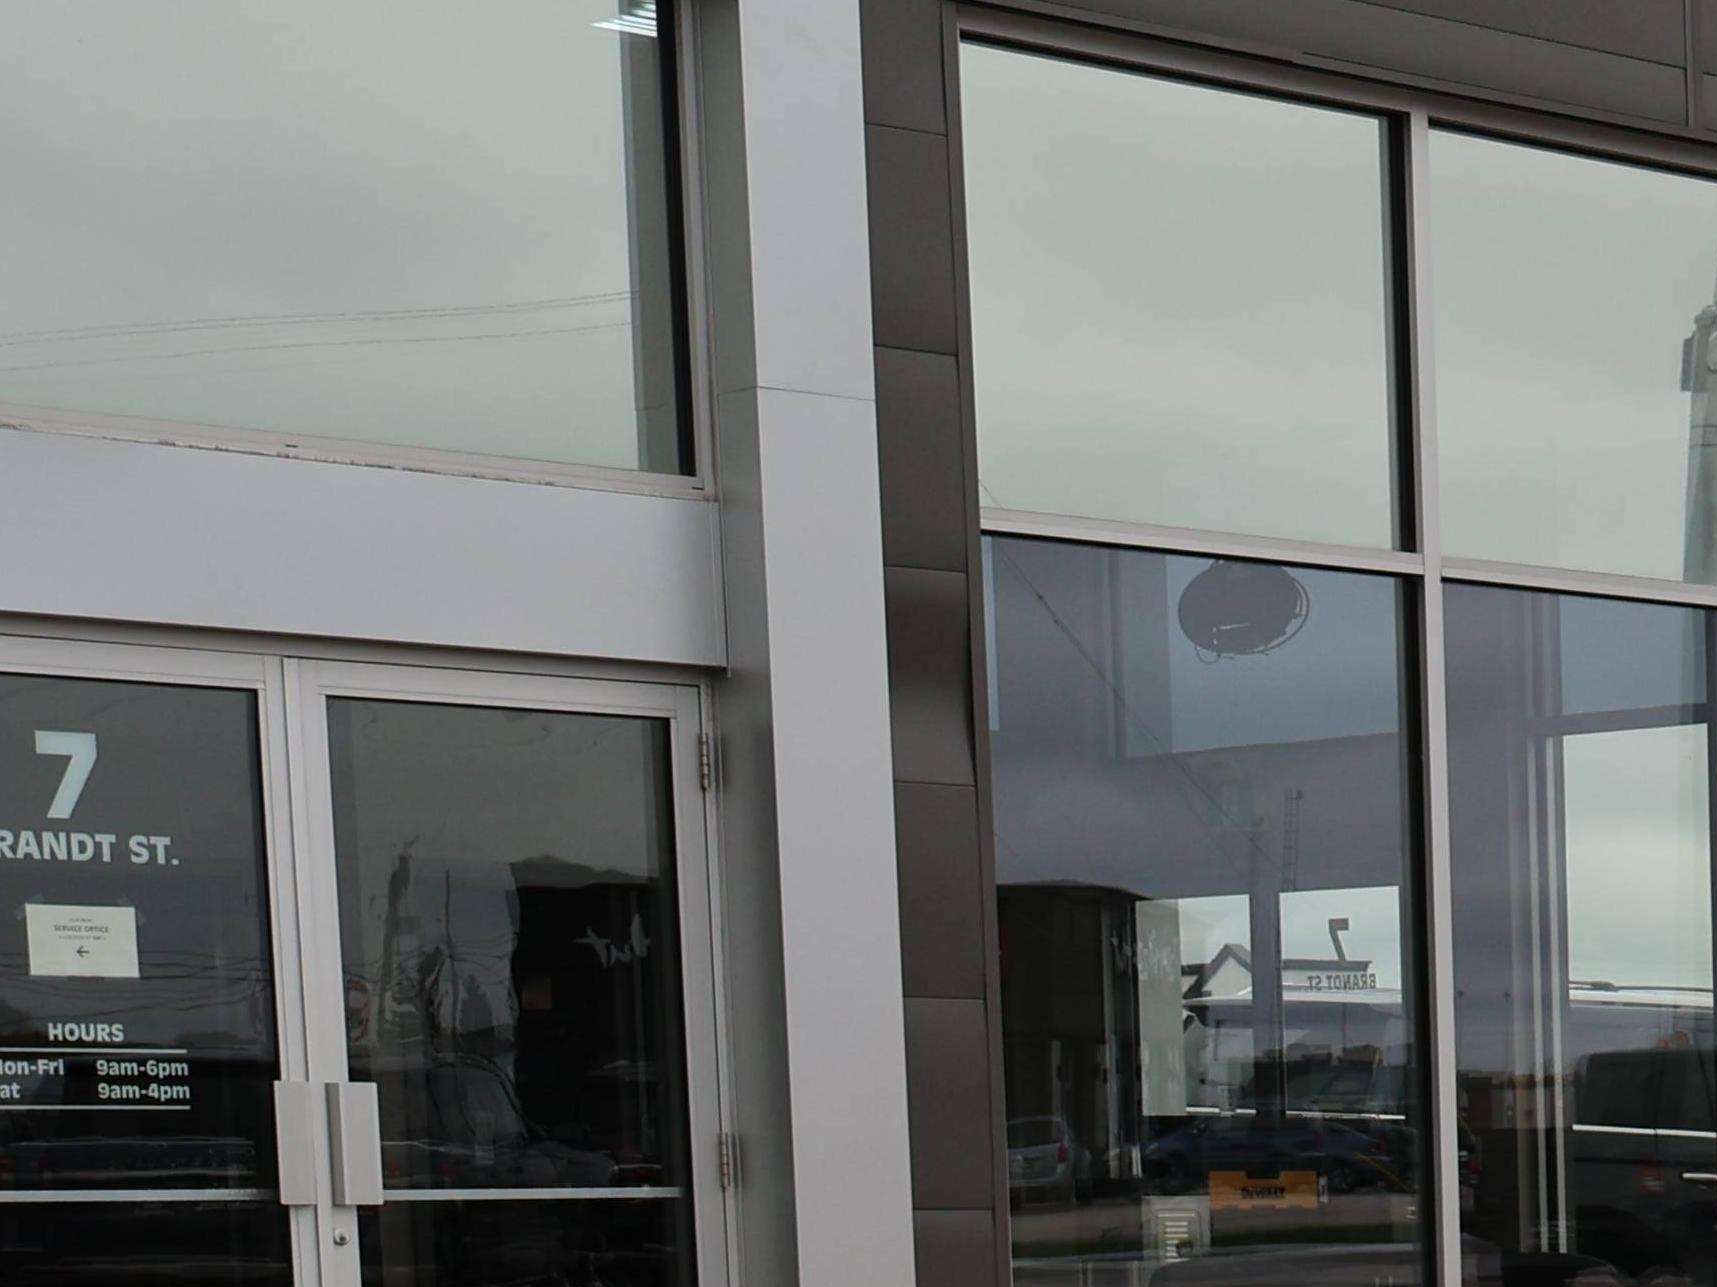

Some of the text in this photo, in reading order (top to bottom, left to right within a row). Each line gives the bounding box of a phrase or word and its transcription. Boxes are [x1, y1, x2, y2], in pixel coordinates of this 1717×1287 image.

[35, 730, 98, 819] 7
[129, 835, 180, 865] ST.
[49, 1022, 124, 1042] HOURS
[0, 1058, 189, 1078] on-Fri 9am-6pm
[98, 1083, 190, 1101] 9am-4pm
